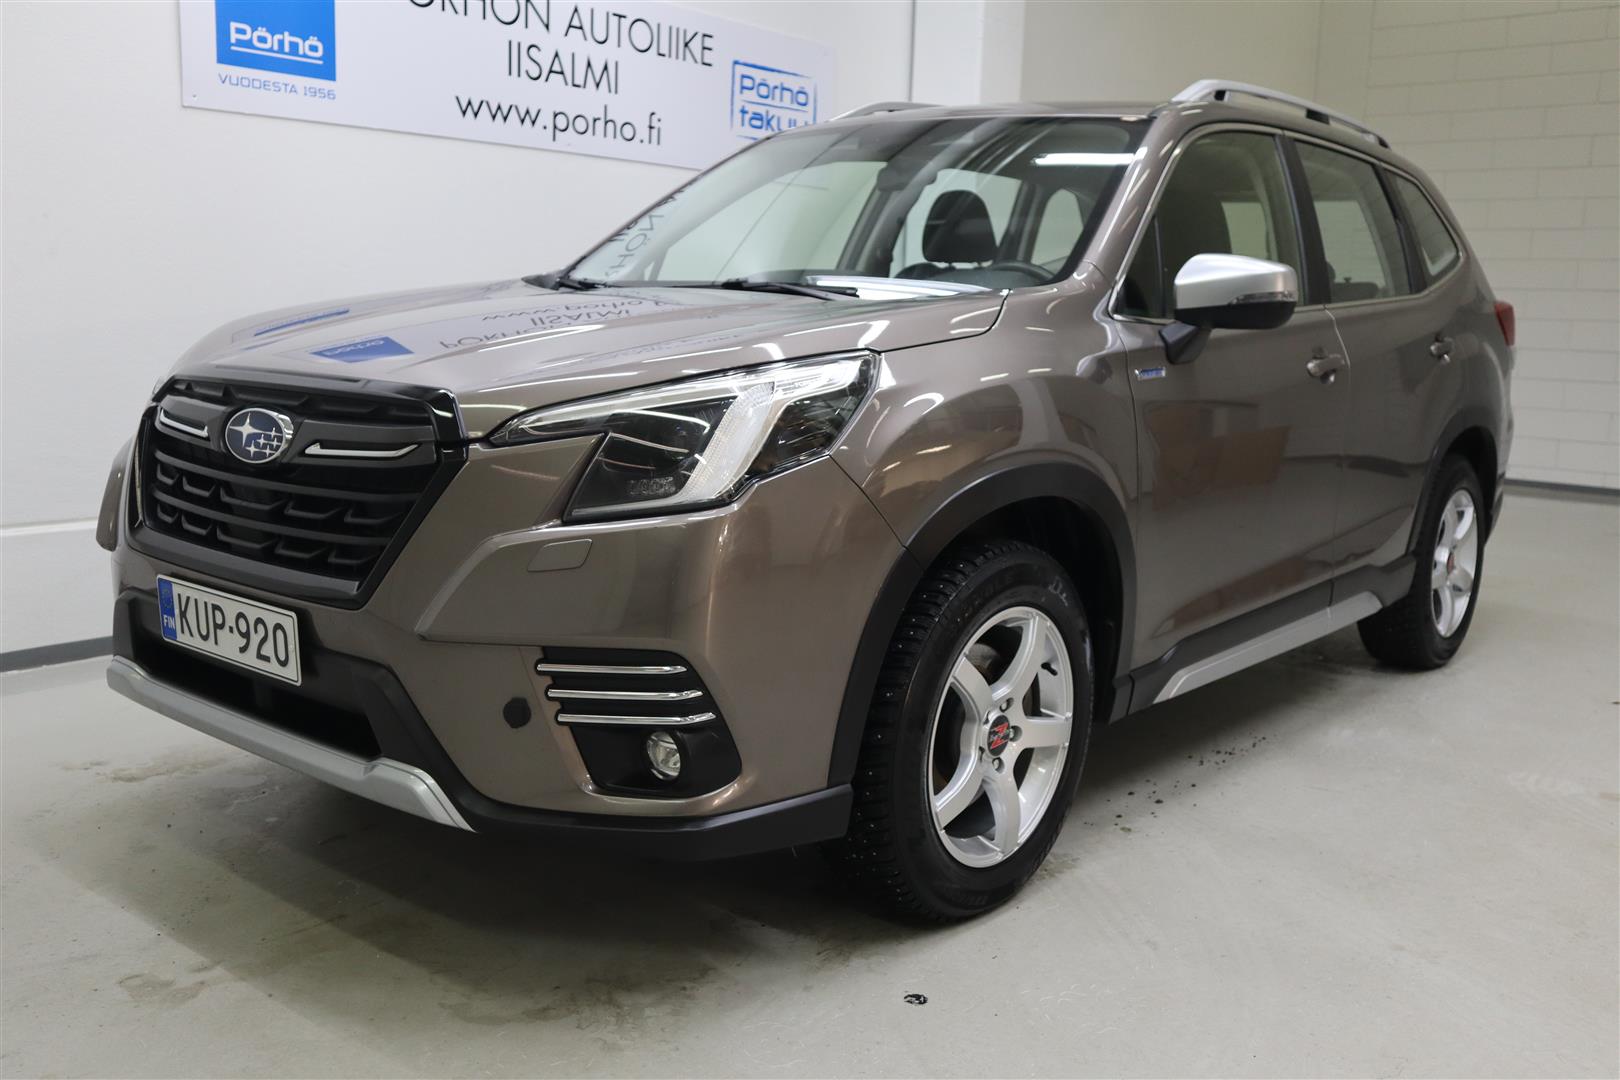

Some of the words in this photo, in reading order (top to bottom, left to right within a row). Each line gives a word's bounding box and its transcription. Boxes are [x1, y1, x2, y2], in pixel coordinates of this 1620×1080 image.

[229, 21, 324, 58] Pörhö
[564, 5, 715, 67] AUTOLIIKE
[218, 73, 298, 95] VUODESTA
[303, 85, 336, 100] 1956
[508, 39, 619, 95] IISALMI
[456, 96, 662, 146] www.porho.fi
[163, 614, 175, 630] FIN
[177, 593, 290, 667] KUP-920
